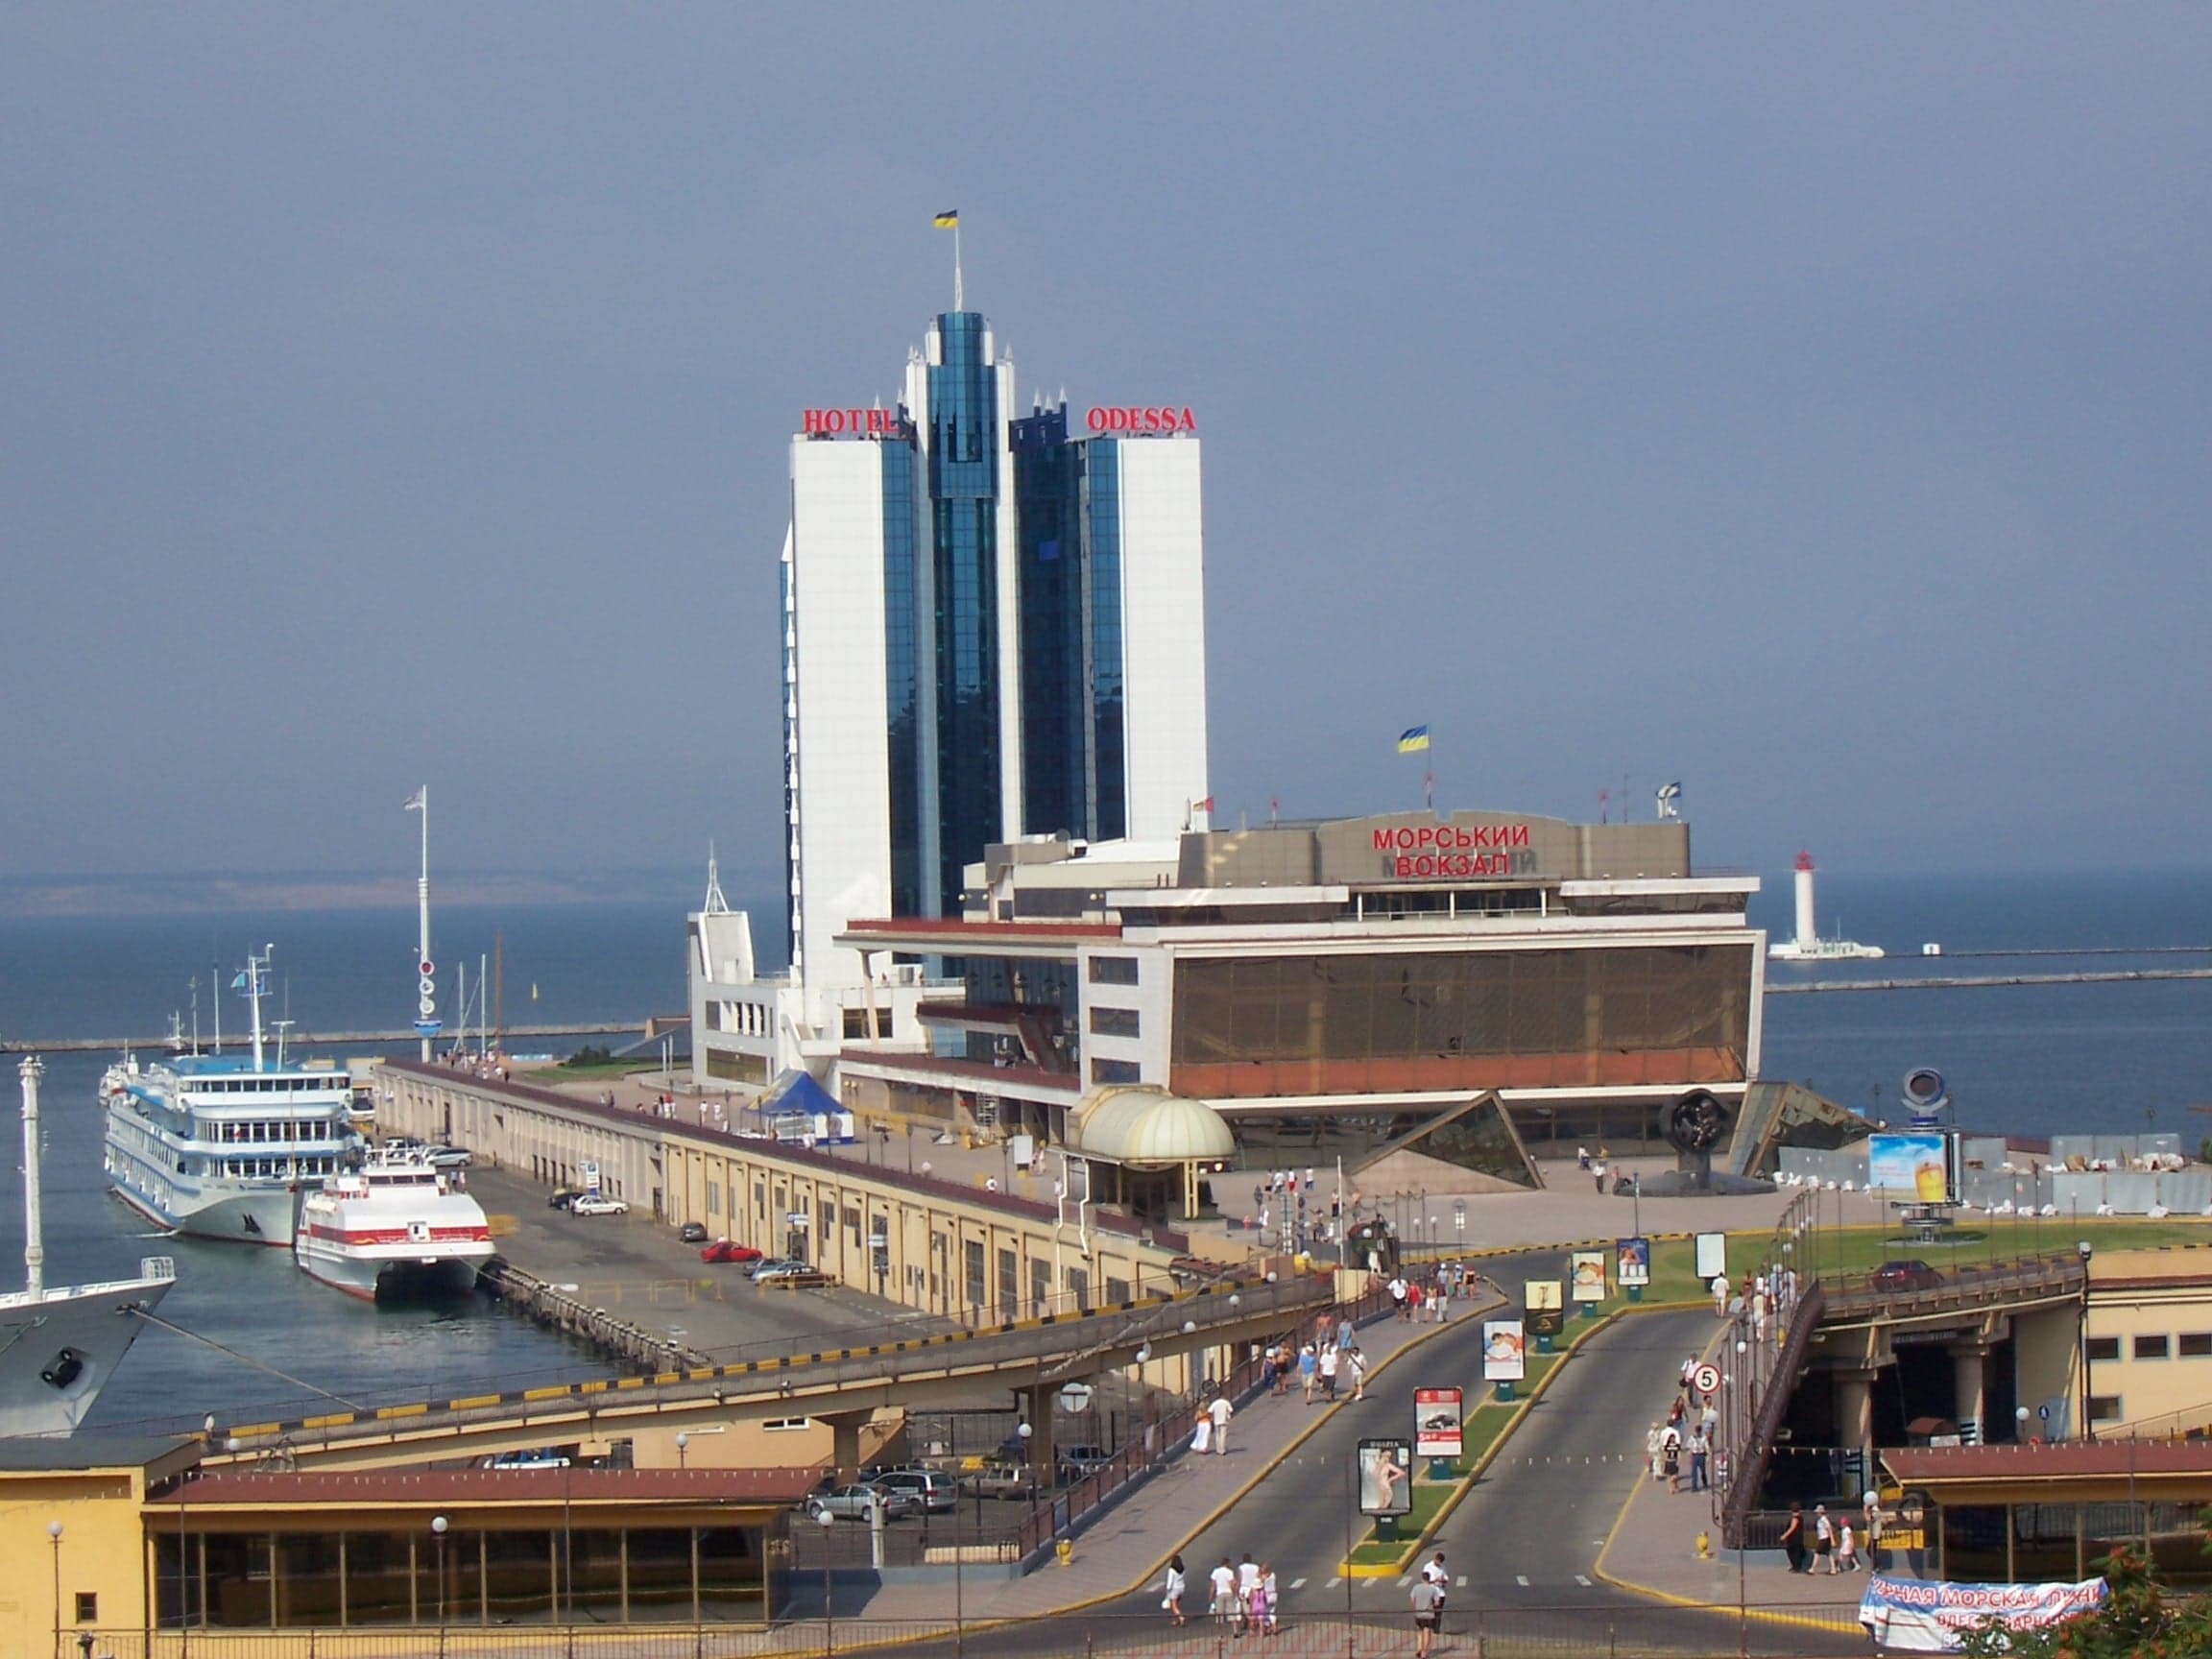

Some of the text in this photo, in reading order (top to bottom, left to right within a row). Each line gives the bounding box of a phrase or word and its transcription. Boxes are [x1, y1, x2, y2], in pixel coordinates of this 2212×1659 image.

[803, 406, 1196, 432] HOTEL ODESSA
[1373, 823, 1528, 850] МОРСЬКИЙ
[1396, 854, 1509, 877] ВОКЗАЛ
[1702, 1370, 1712, 1387] 5
[1941, 1588, 2041, 1607] МОРСКАЯ
